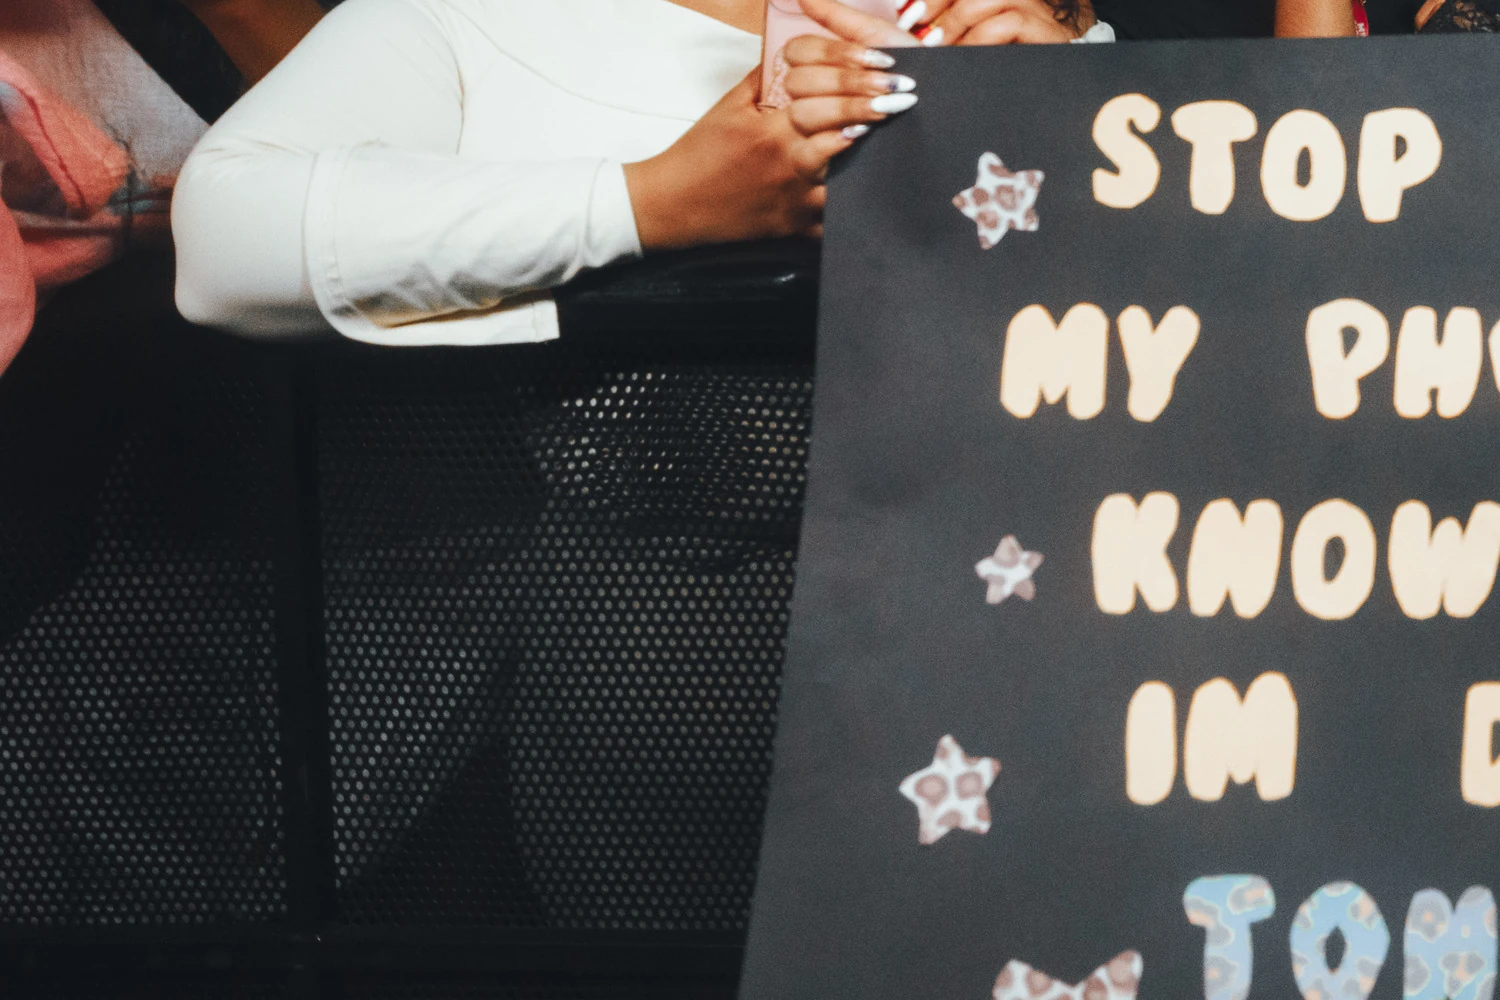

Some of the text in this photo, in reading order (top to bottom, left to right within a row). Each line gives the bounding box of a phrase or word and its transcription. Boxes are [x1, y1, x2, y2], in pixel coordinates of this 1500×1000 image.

[1091, 92, 1443, 224] STOP
[999, 301, 1201, 423] MY
[1124, 669, 1299, 806] IM
